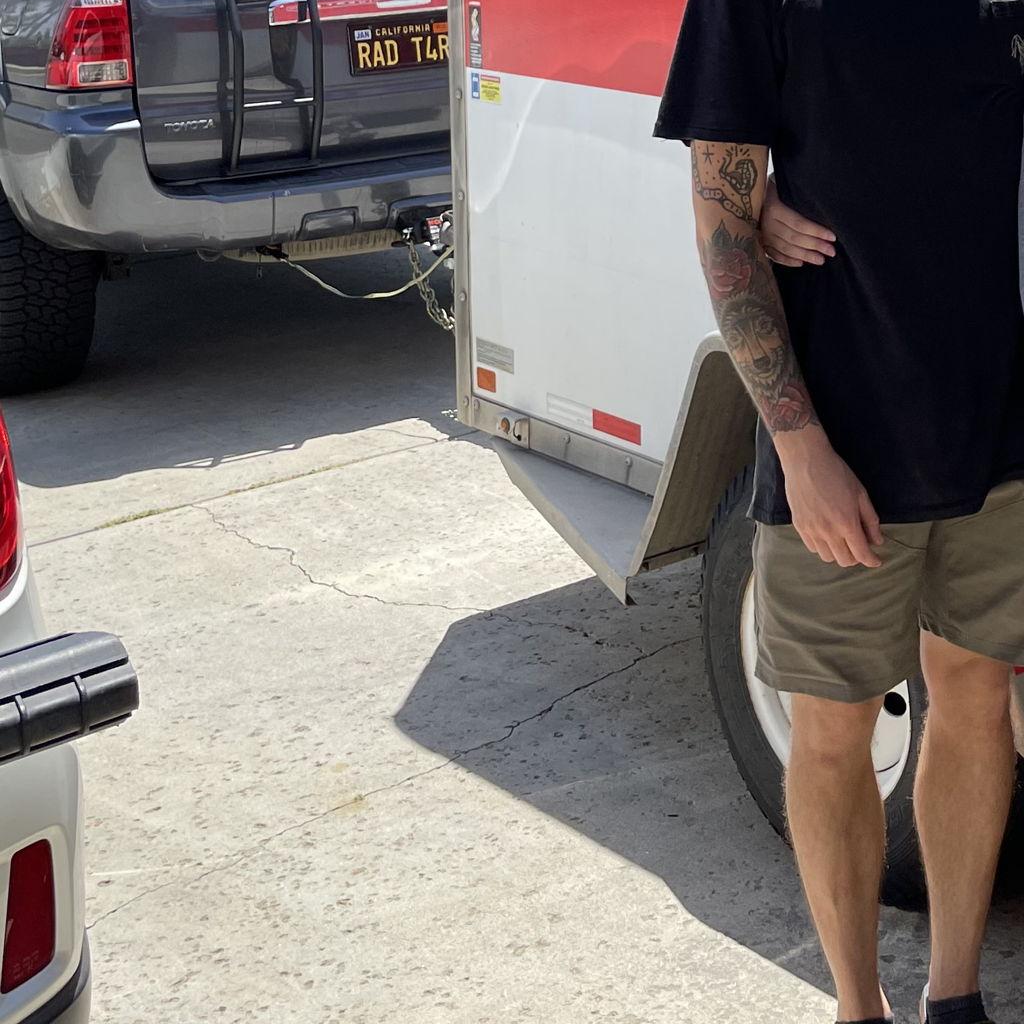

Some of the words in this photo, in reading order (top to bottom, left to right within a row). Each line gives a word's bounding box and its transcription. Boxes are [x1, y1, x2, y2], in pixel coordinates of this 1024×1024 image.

[356, 31, 371, 40] JAN
[375, 23, 431, 37] CALIFORNIA
[357, 39, 399, 69] RAD
[410, 34, 450, 63] T4R
[164, 118, 216, 132] TOYOTA
